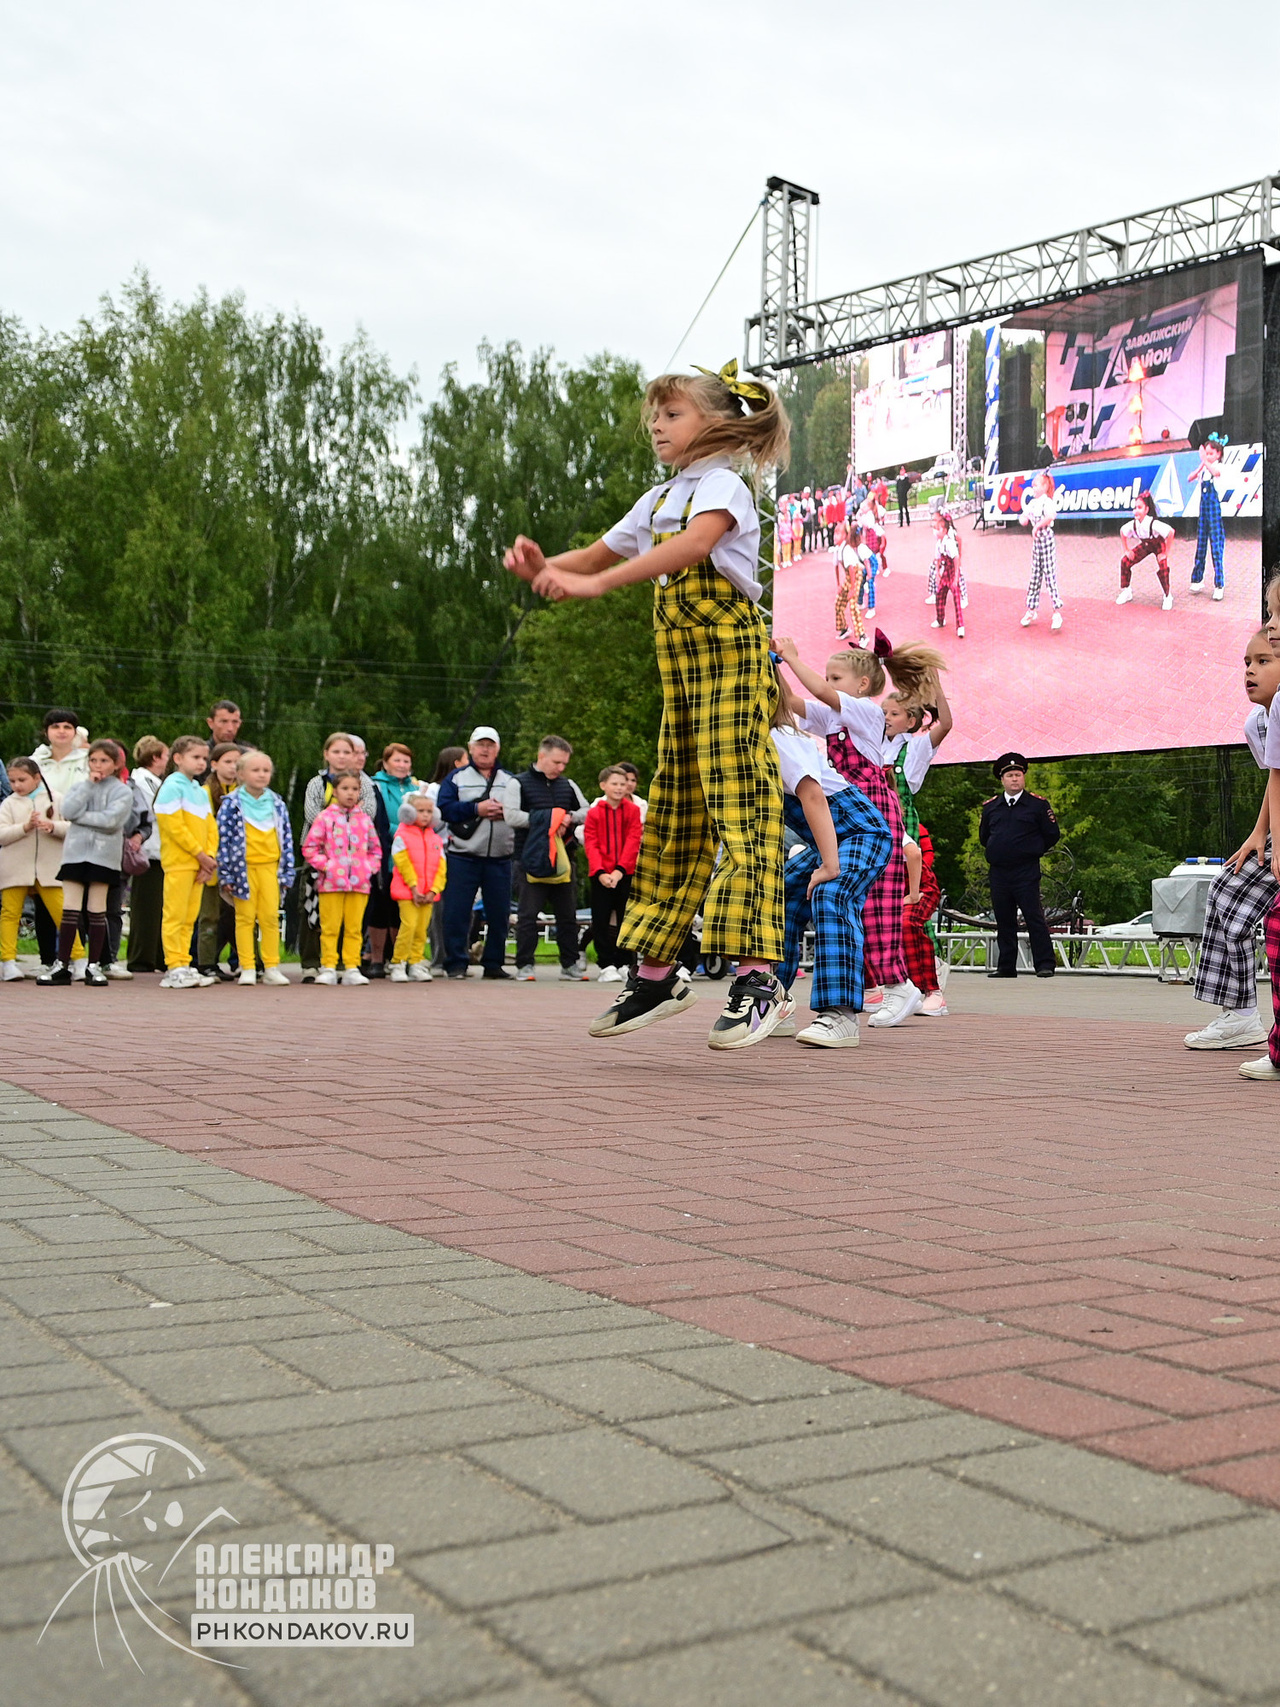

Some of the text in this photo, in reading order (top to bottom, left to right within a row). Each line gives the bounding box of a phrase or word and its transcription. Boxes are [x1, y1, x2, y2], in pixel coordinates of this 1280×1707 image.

[1126, 316, 1193, 352] ЗАВОЛЖСКИЙ
[998, 475, 1025, 513] 65
[1055, 477, 1142, 512] билеем!
